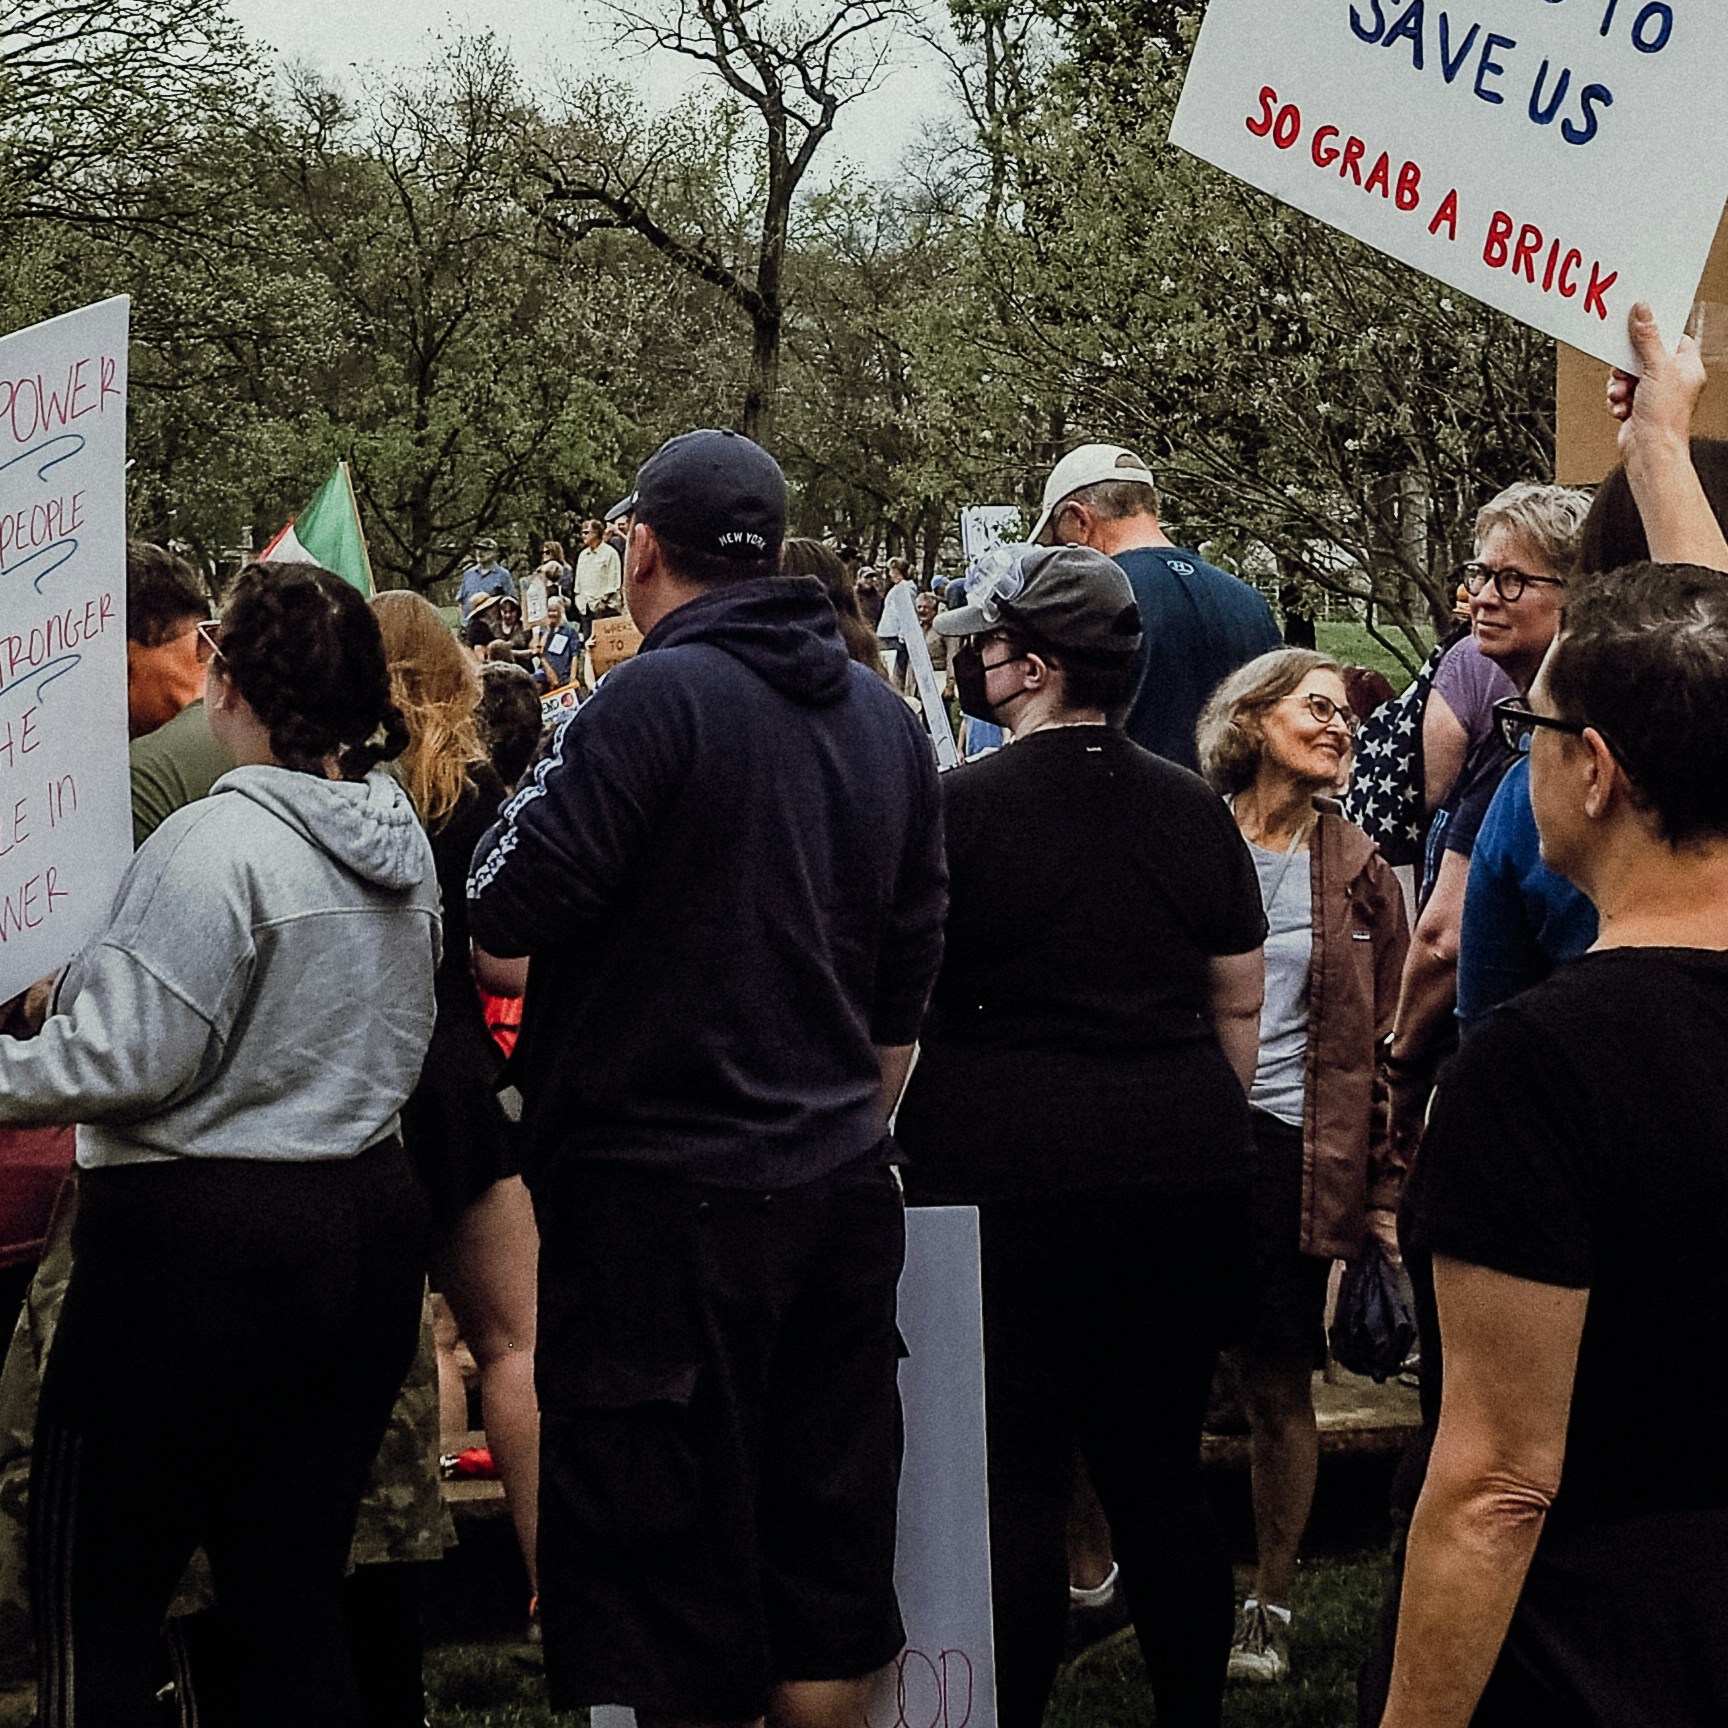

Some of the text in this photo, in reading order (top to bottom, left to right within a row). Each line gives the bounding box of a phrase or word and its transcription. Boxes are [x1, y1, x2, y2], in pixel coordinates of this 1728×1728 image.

[1528, 59, 1613, 145] US
[1246, 86, 1618, 320] SO GRAB A BRICK
[0, 490, 85, 569] PEOPLE
[718, 531, 767, 551] NEW YORK
